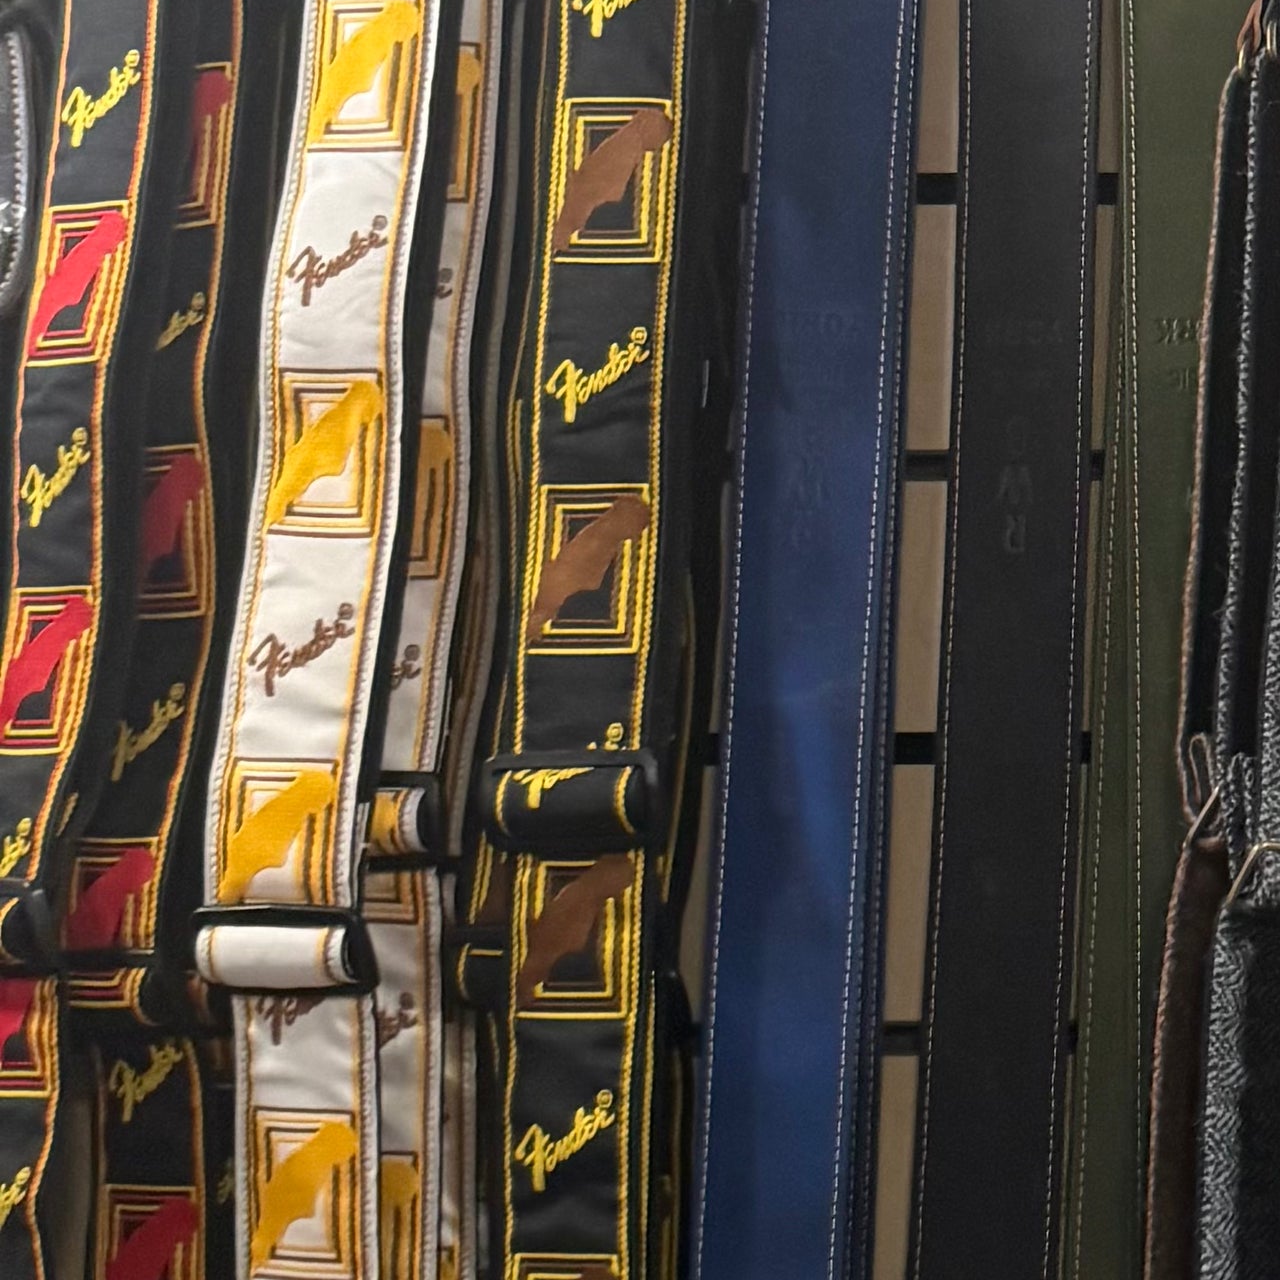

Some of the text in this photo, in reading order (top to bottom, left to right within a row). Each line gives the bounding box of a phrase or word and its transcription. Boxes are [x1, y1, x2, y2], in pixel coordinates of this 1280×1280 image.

[62, 63, 140, 147] Fender
[286, 228, 389, 306] Fender
[547, 340, 650, 423] Fender
[21, 440, 90, 527] Fender
[247, 615, 357, 698] Fender
[515, 1101, 615, 1192] Fender
